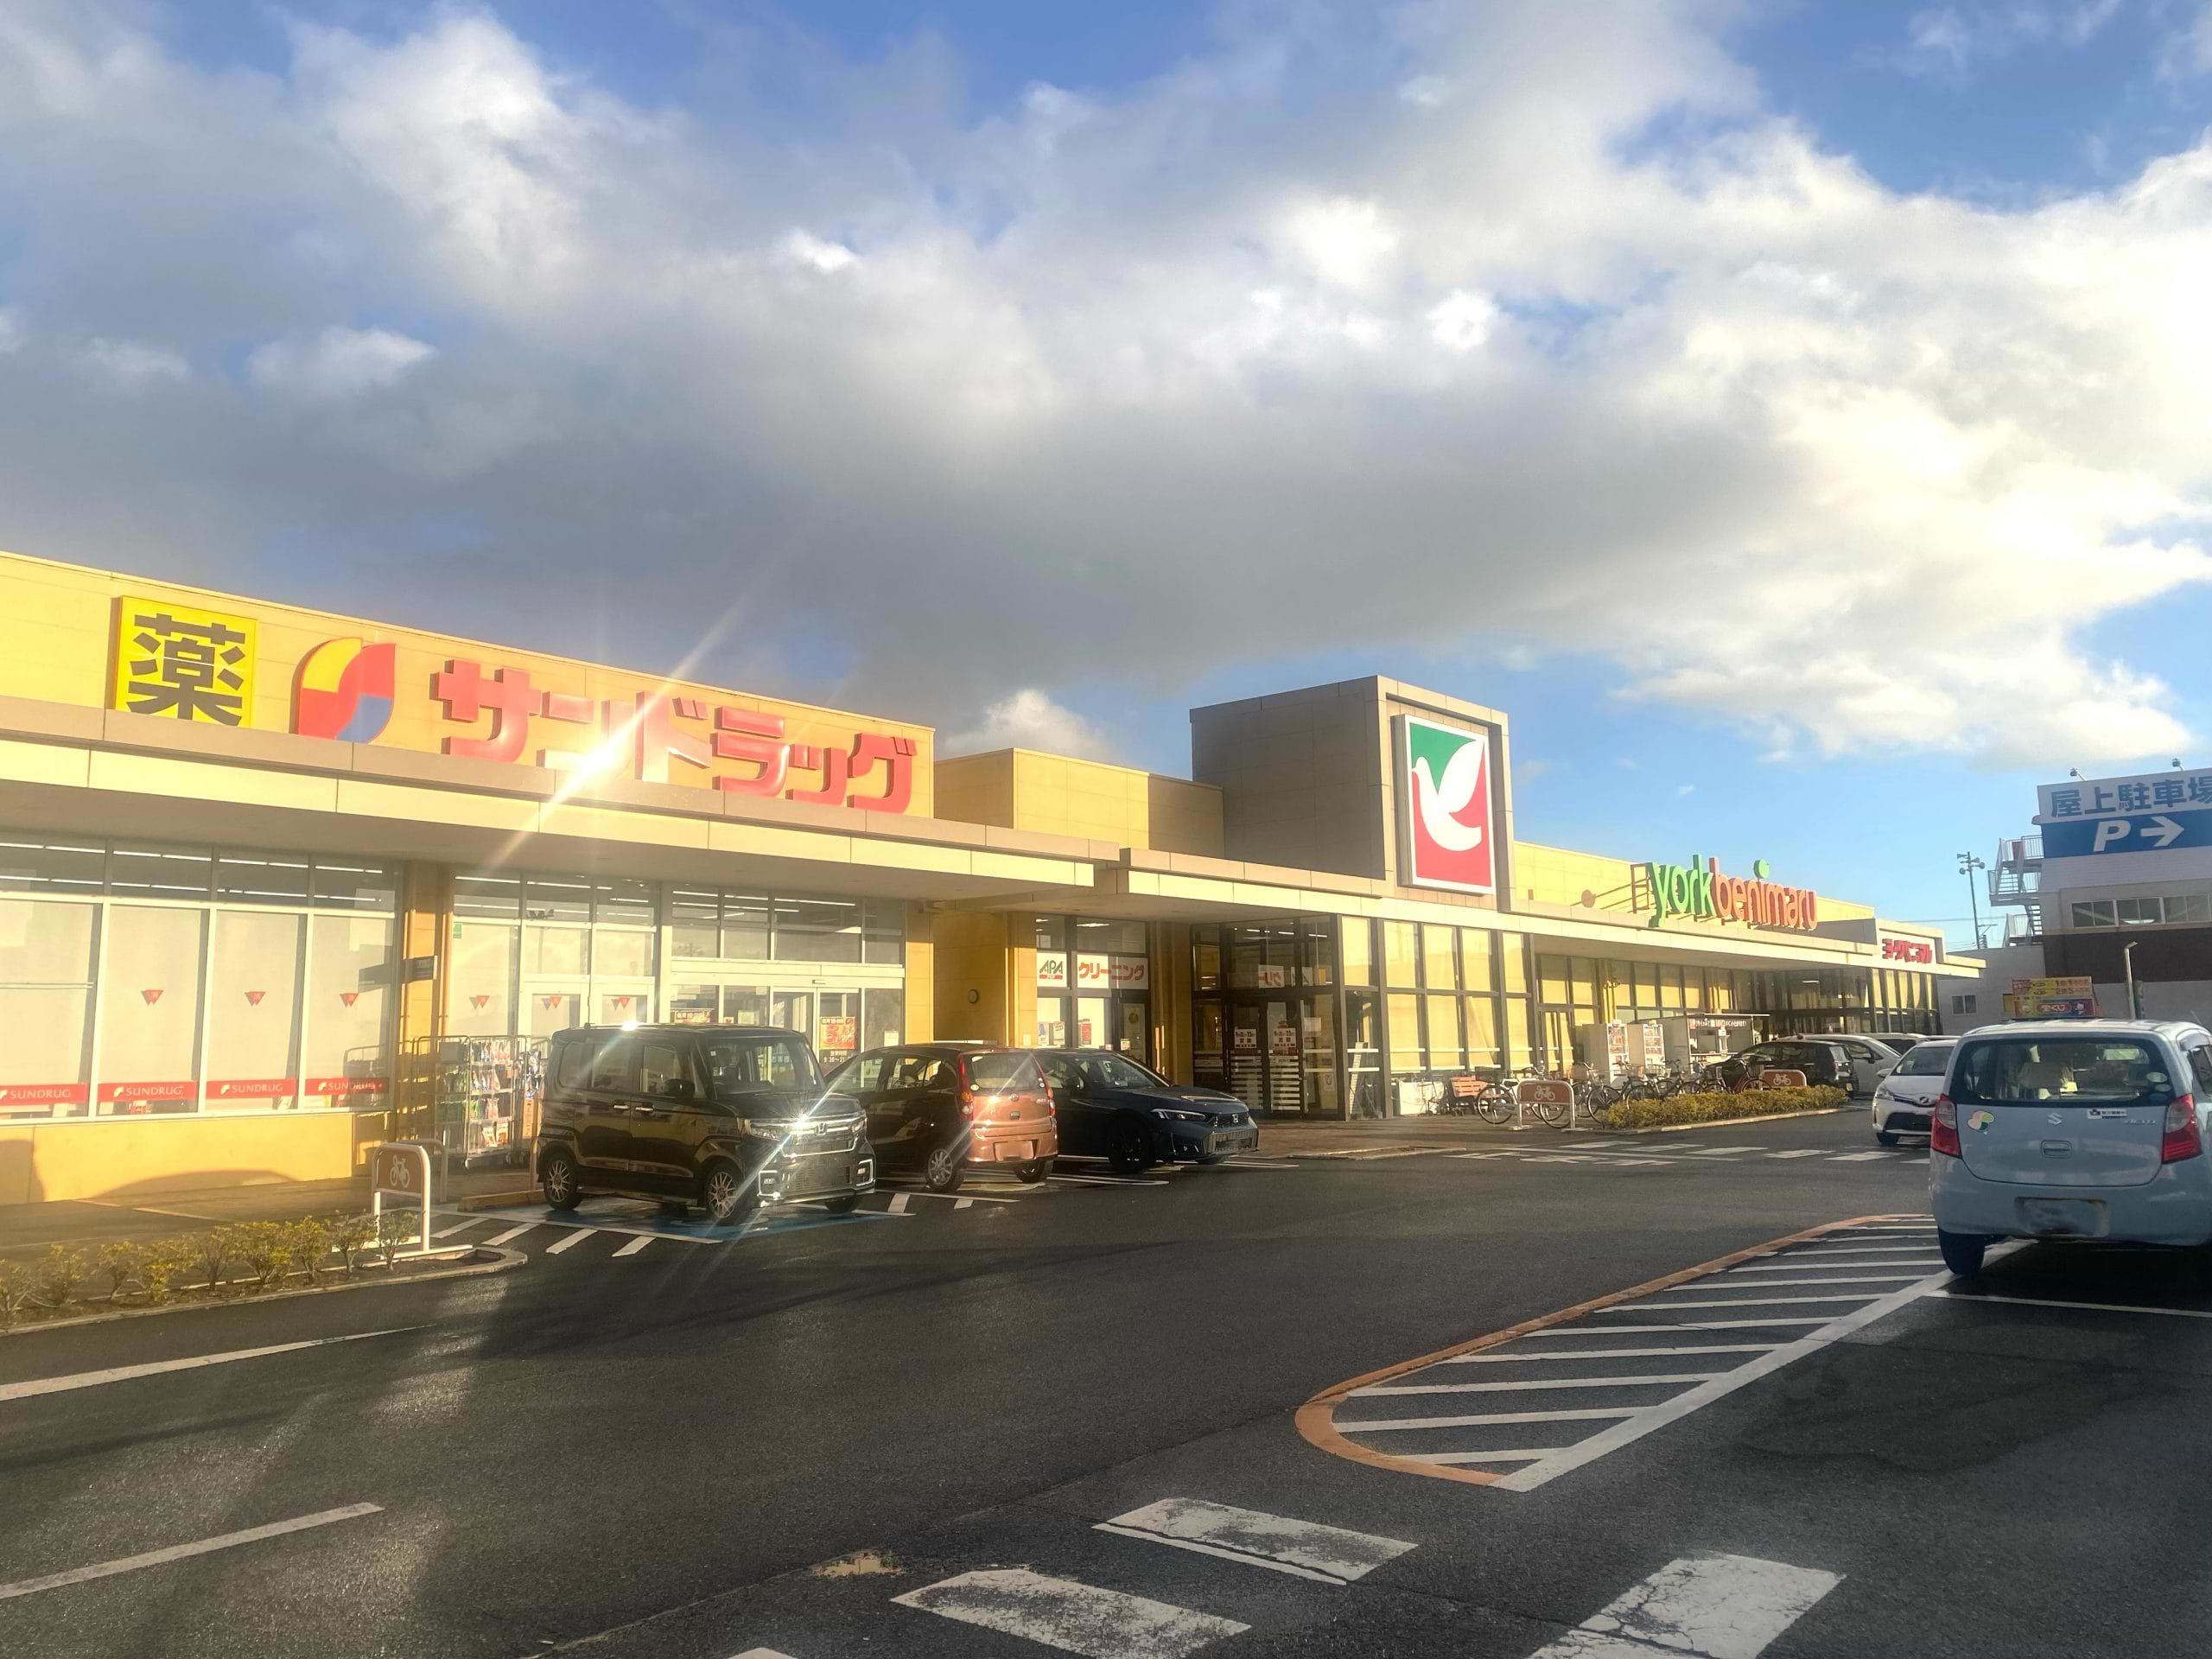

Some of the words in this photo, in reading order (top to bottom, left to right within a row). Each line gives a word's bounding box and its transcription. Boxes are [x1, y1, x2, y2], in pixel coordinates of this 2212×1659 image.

[127, 613, 245, 727] 薬
[430, 659, 918, 815] サンドラッグ
[2051, 777, 2212, 817] 屋上駐車場
[2094, 819, 2131, 852] P
[1039, 959, 1063, 975] APA
[1078, 962, 1145, 981] クリーニング
[10, 1088, 72, 1099] SUNDRUG
[125, 1086, 182, 1097] SUNDRUG
[232, 1084, 283, 1093] SUNDRUG
